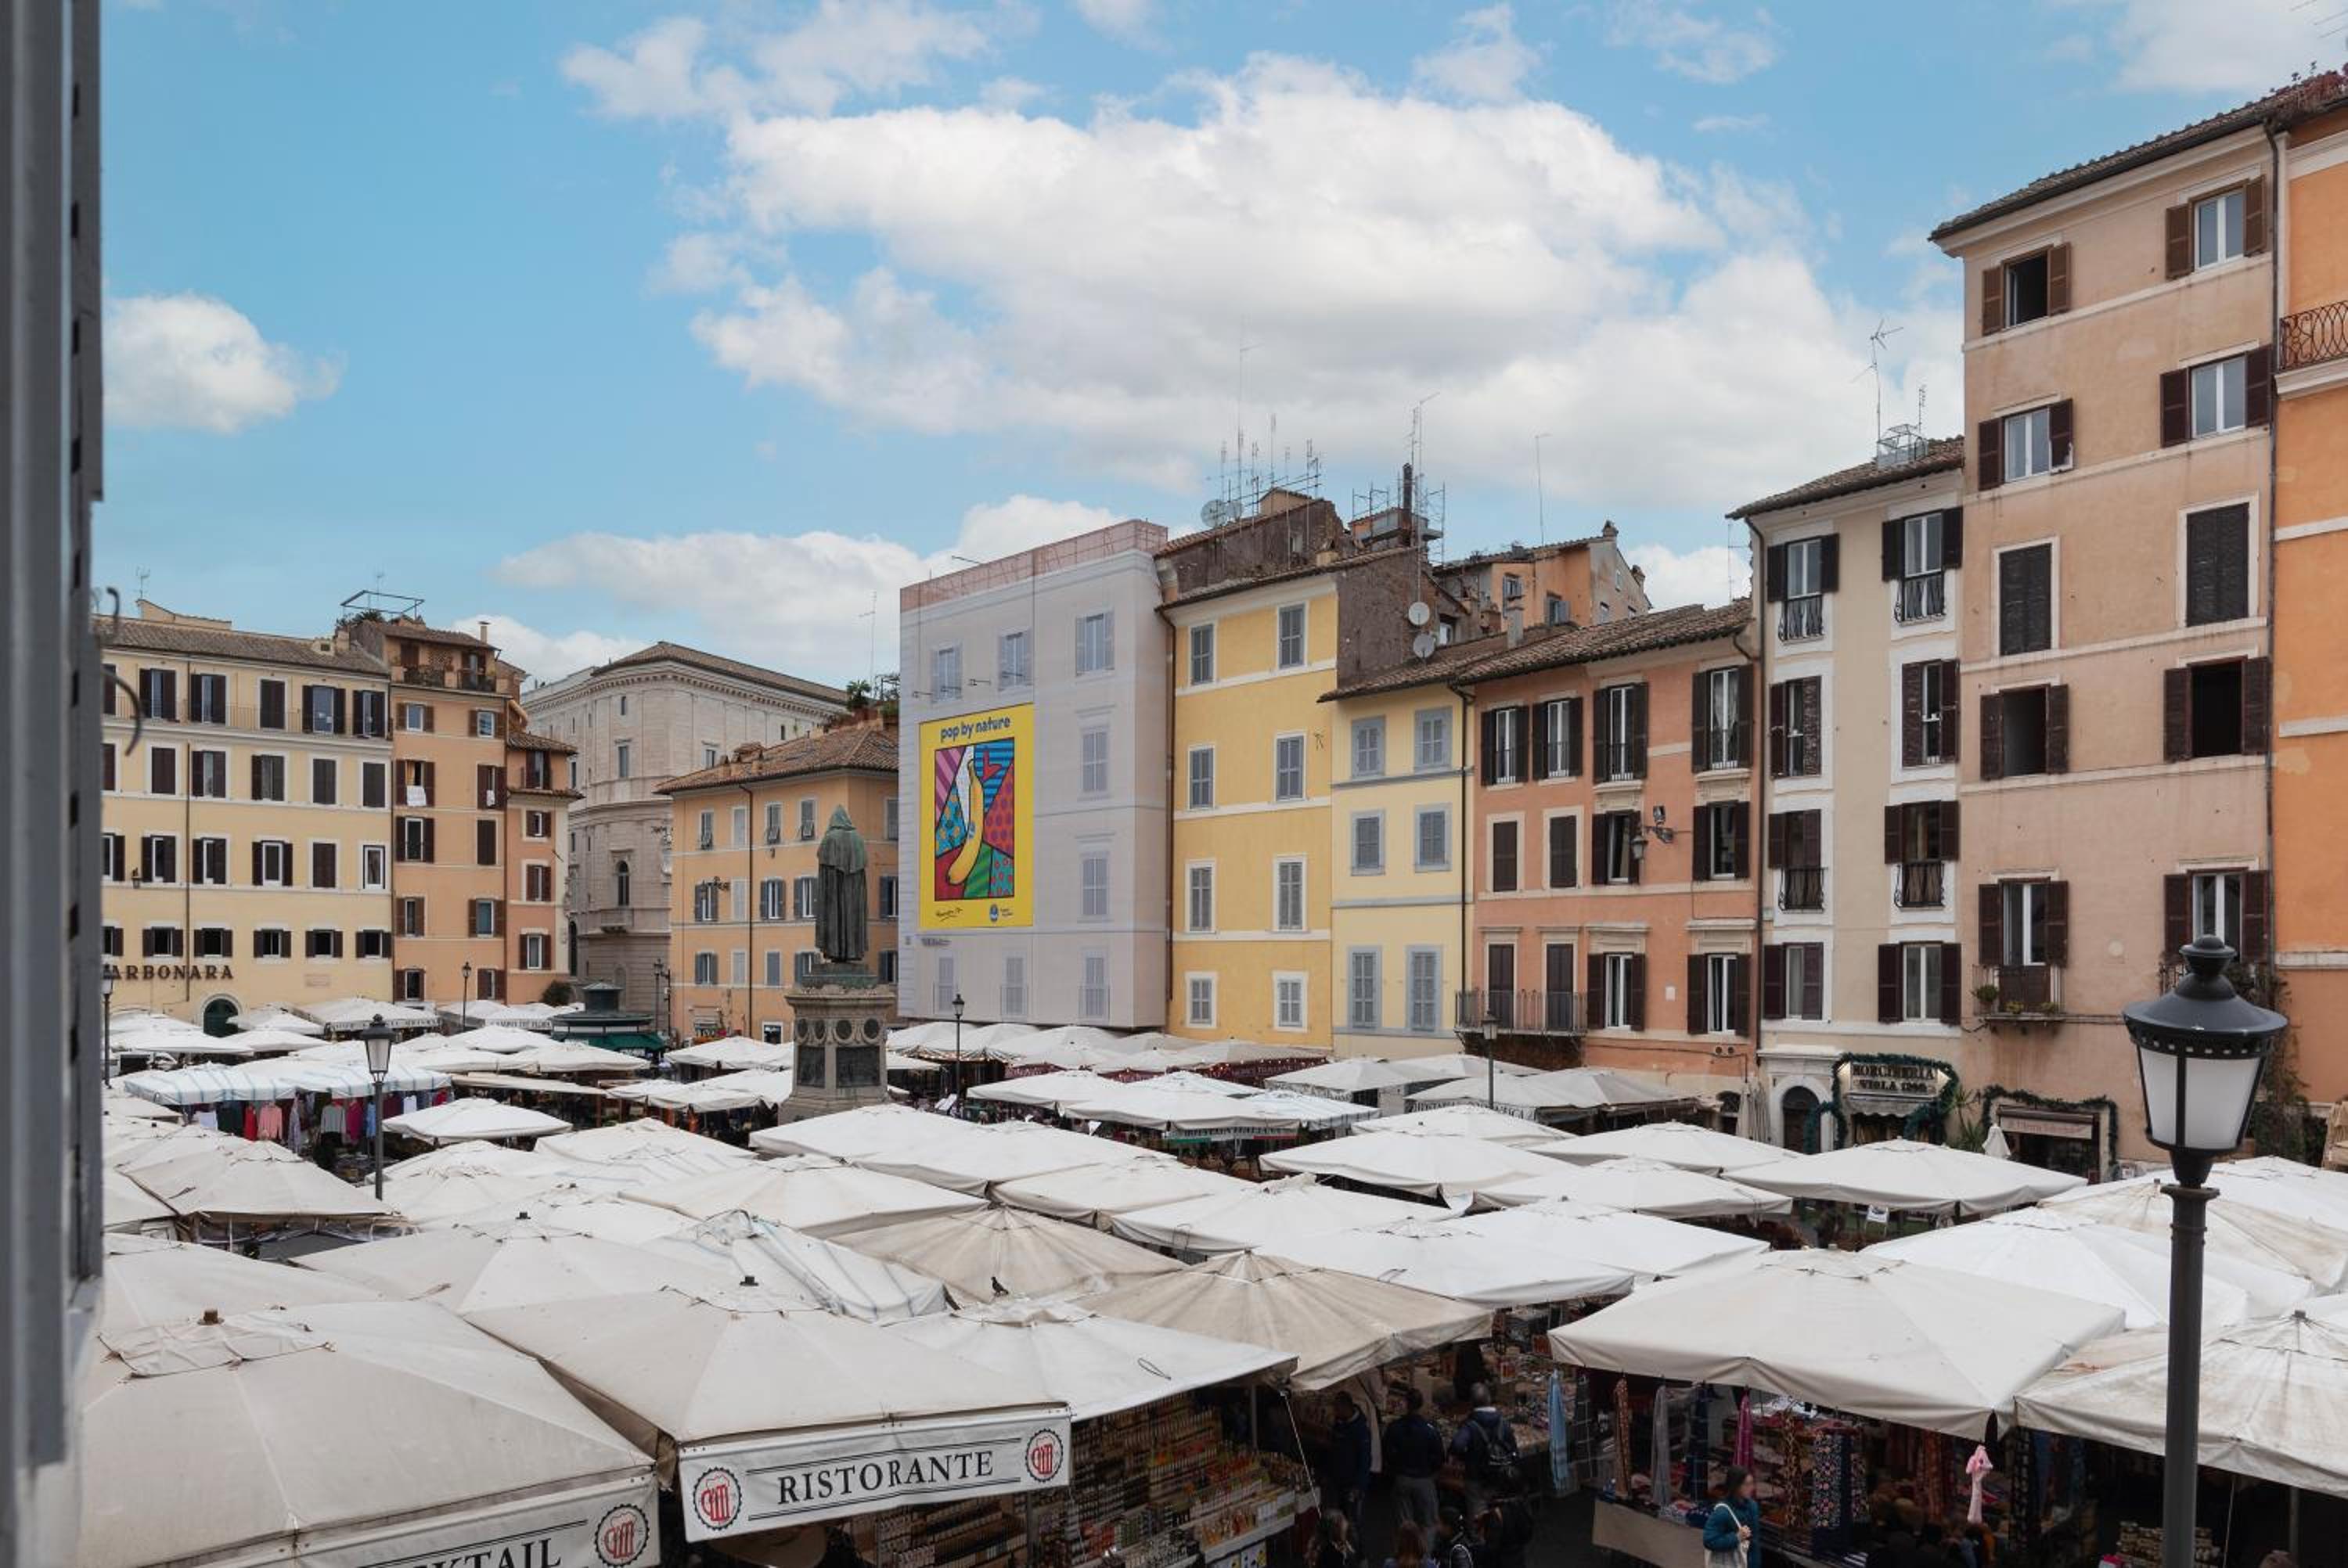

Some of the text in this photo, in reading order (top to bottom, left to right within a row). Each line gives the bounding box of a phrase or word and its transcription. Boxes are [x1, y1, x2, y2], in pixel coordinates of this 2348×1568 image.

[940, 716, 1010, 743] pop by nature
[110, 964, 234, 980] ARBONARA
[777, 1450, 993, 1505] RISTORANTE
